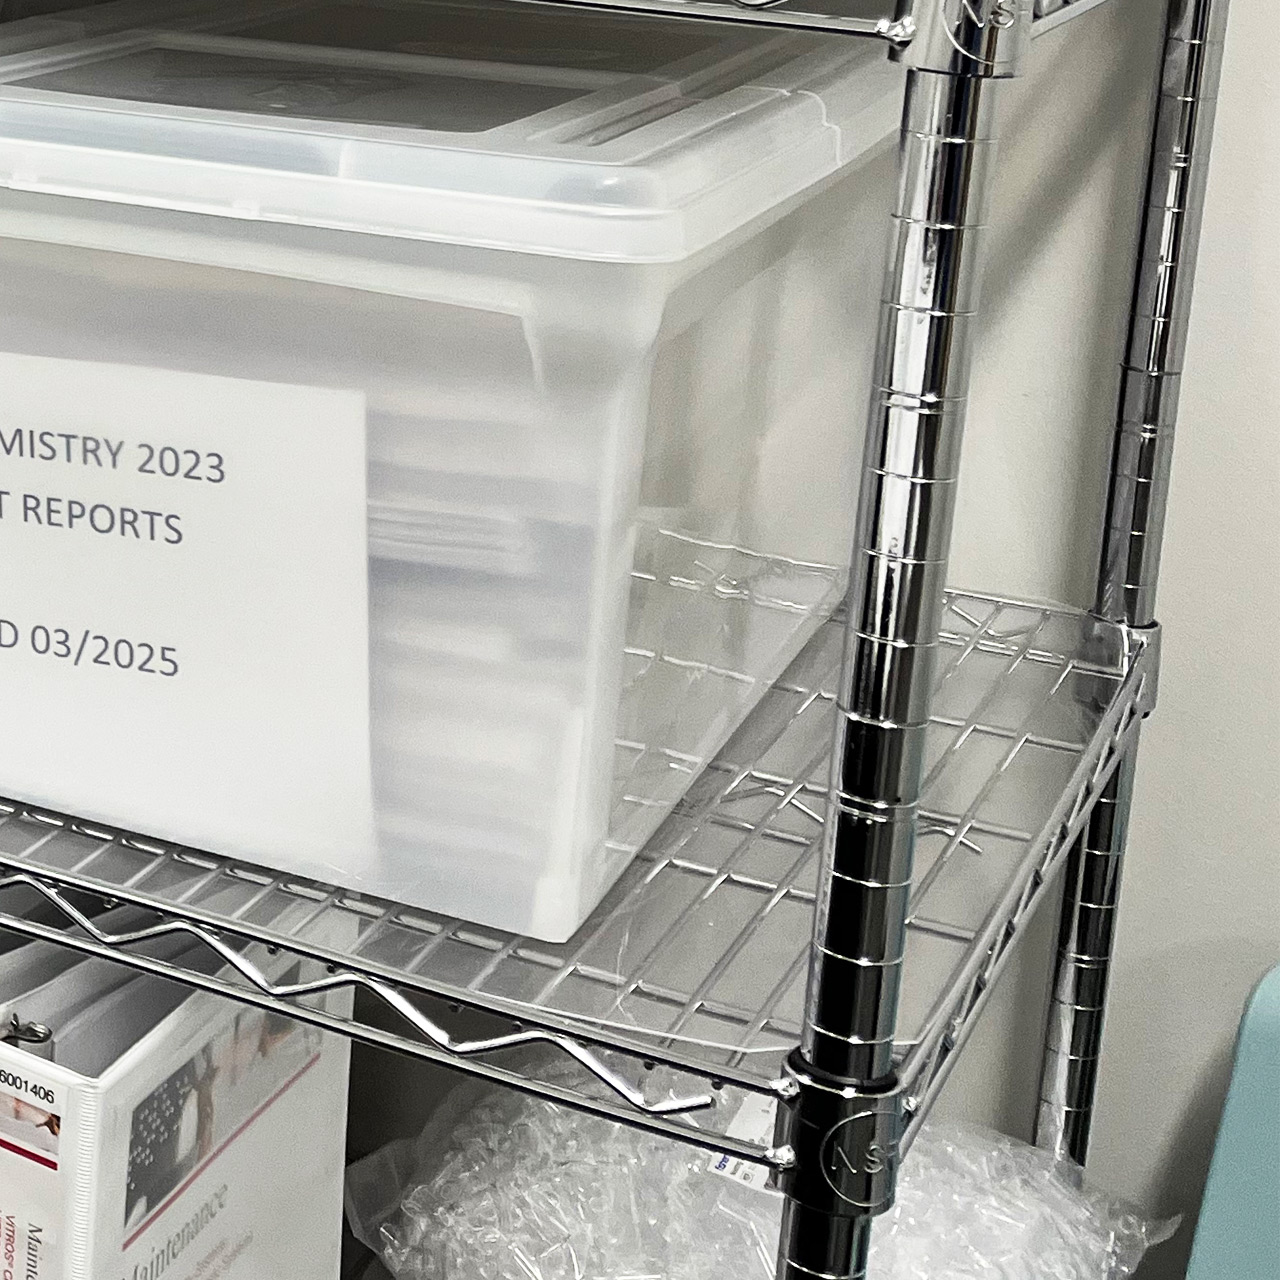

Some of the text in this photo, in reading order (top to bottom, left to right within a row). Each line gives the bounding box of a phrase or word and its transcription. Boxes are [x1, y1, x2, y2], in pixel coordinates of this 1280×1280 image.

[137, 443, 225, 483] 2023
[23, 494, 183, 545] REPORTS
[31, 625, 179, 677] 03/2025
